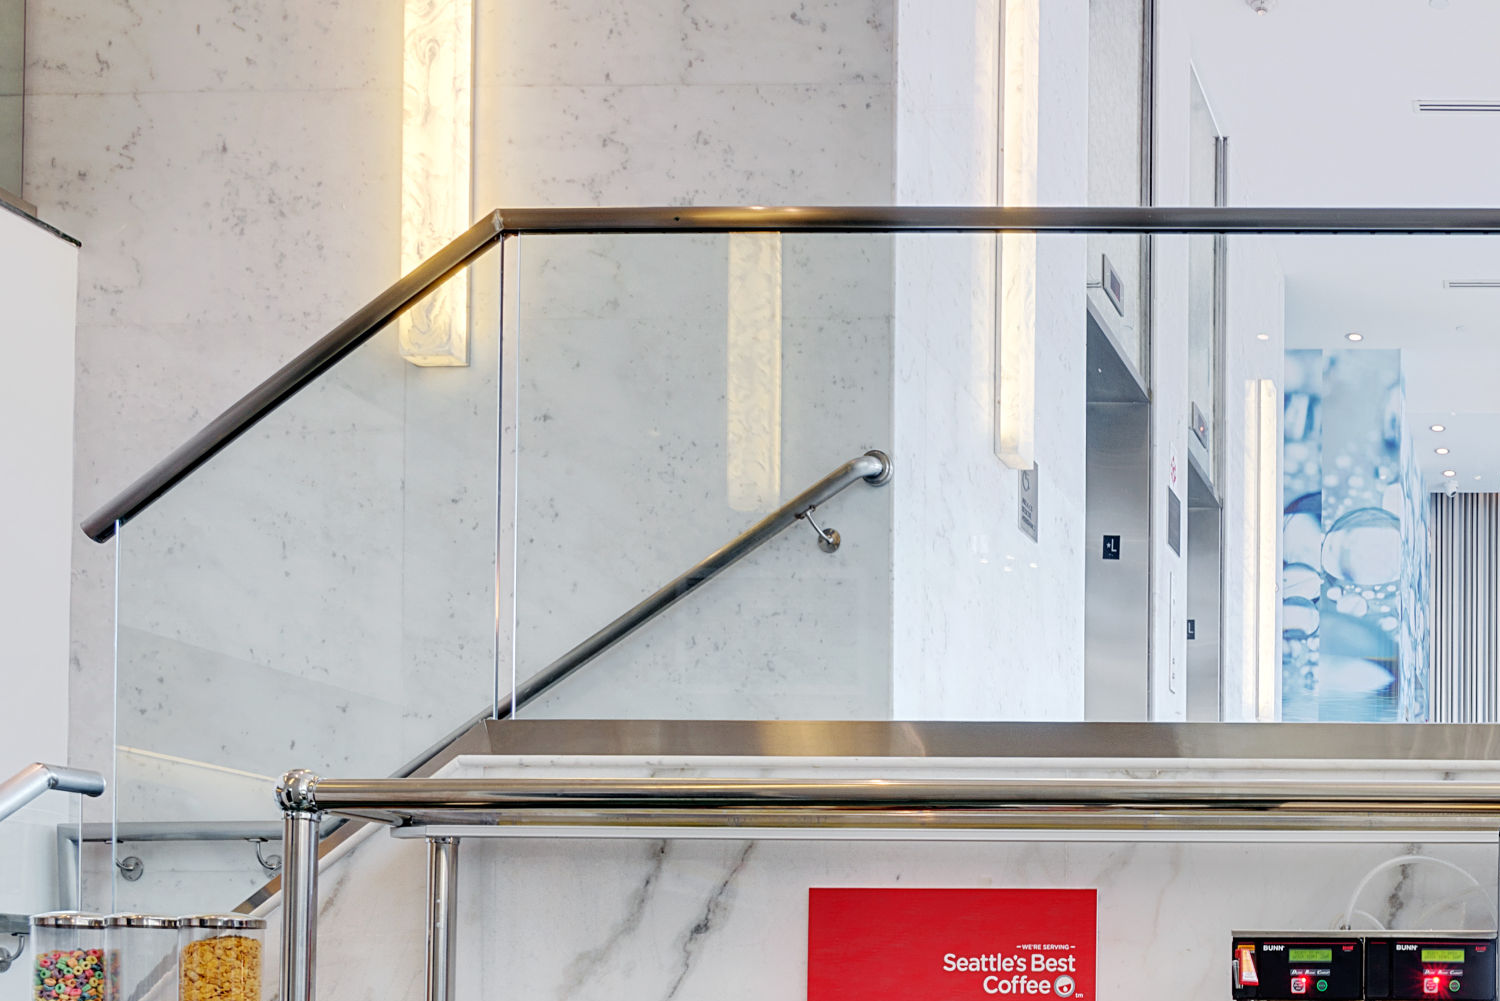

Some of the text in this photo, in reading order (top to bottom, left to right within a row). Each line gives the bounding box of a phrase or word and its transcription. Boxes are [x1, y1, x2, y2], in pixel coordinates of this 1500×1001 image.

[943, 953, 1076, 972] Seattle's Best
[983, 975, 1051, 995] Coffee
